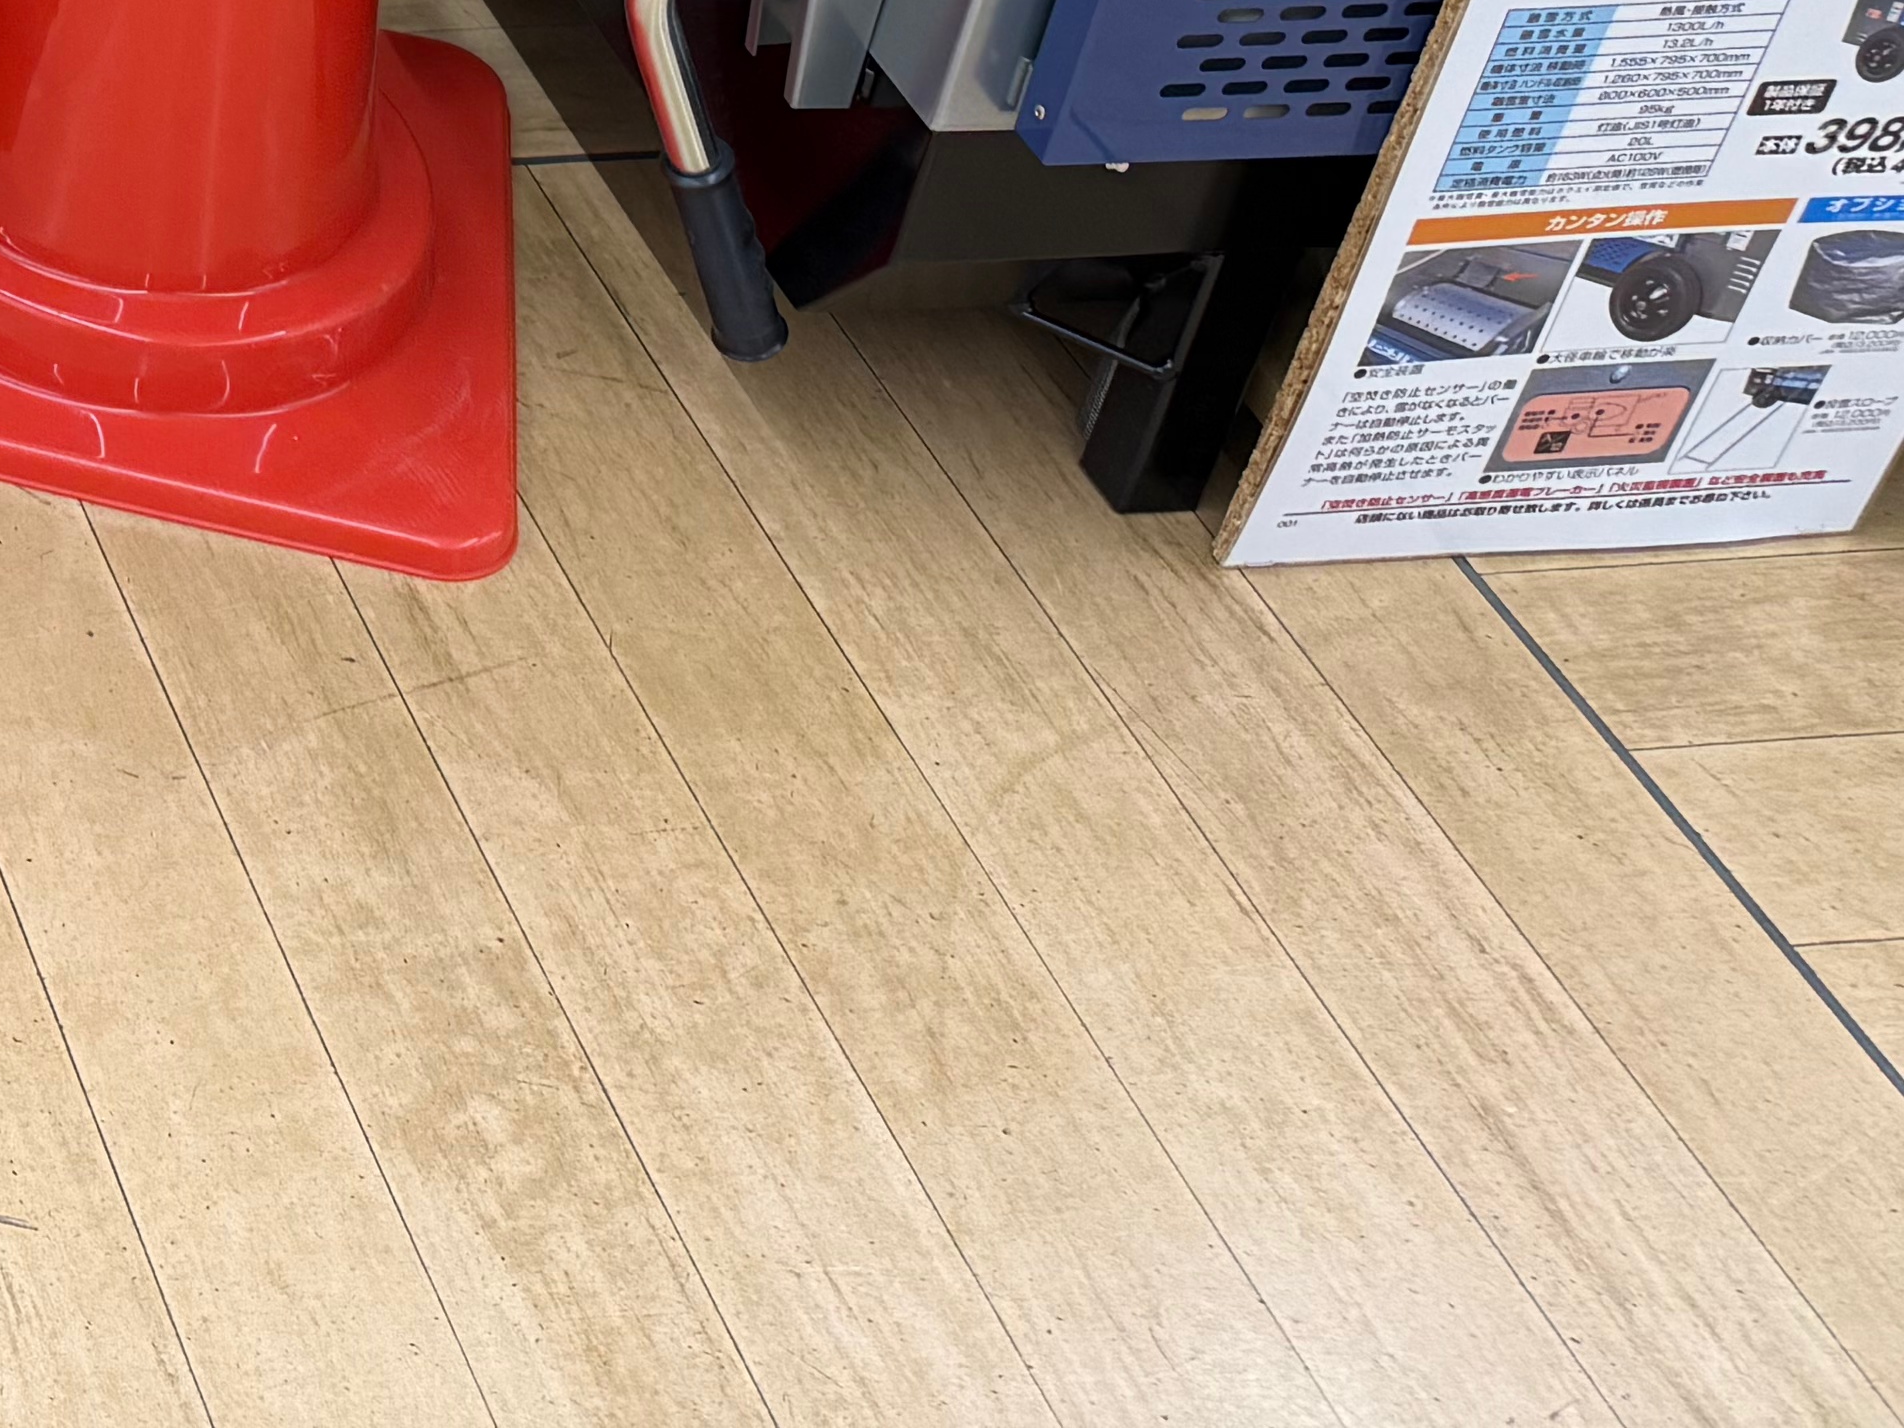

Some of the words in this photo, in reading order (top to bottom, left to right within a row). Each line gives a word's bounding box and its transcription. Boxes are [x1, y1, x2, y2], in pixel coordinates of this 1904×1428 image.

[1666, 20, 1724, 32] 1300L/h
[1662, 37, 1714, 49] 13.2L/h
[1759, 136, 1801, 155] 本体
[1607, 151, 1663, 163] AC100V
[1545, 210, 1668, 232] カンタン操作
[1367, 364, 1425, 379] 安全装置
